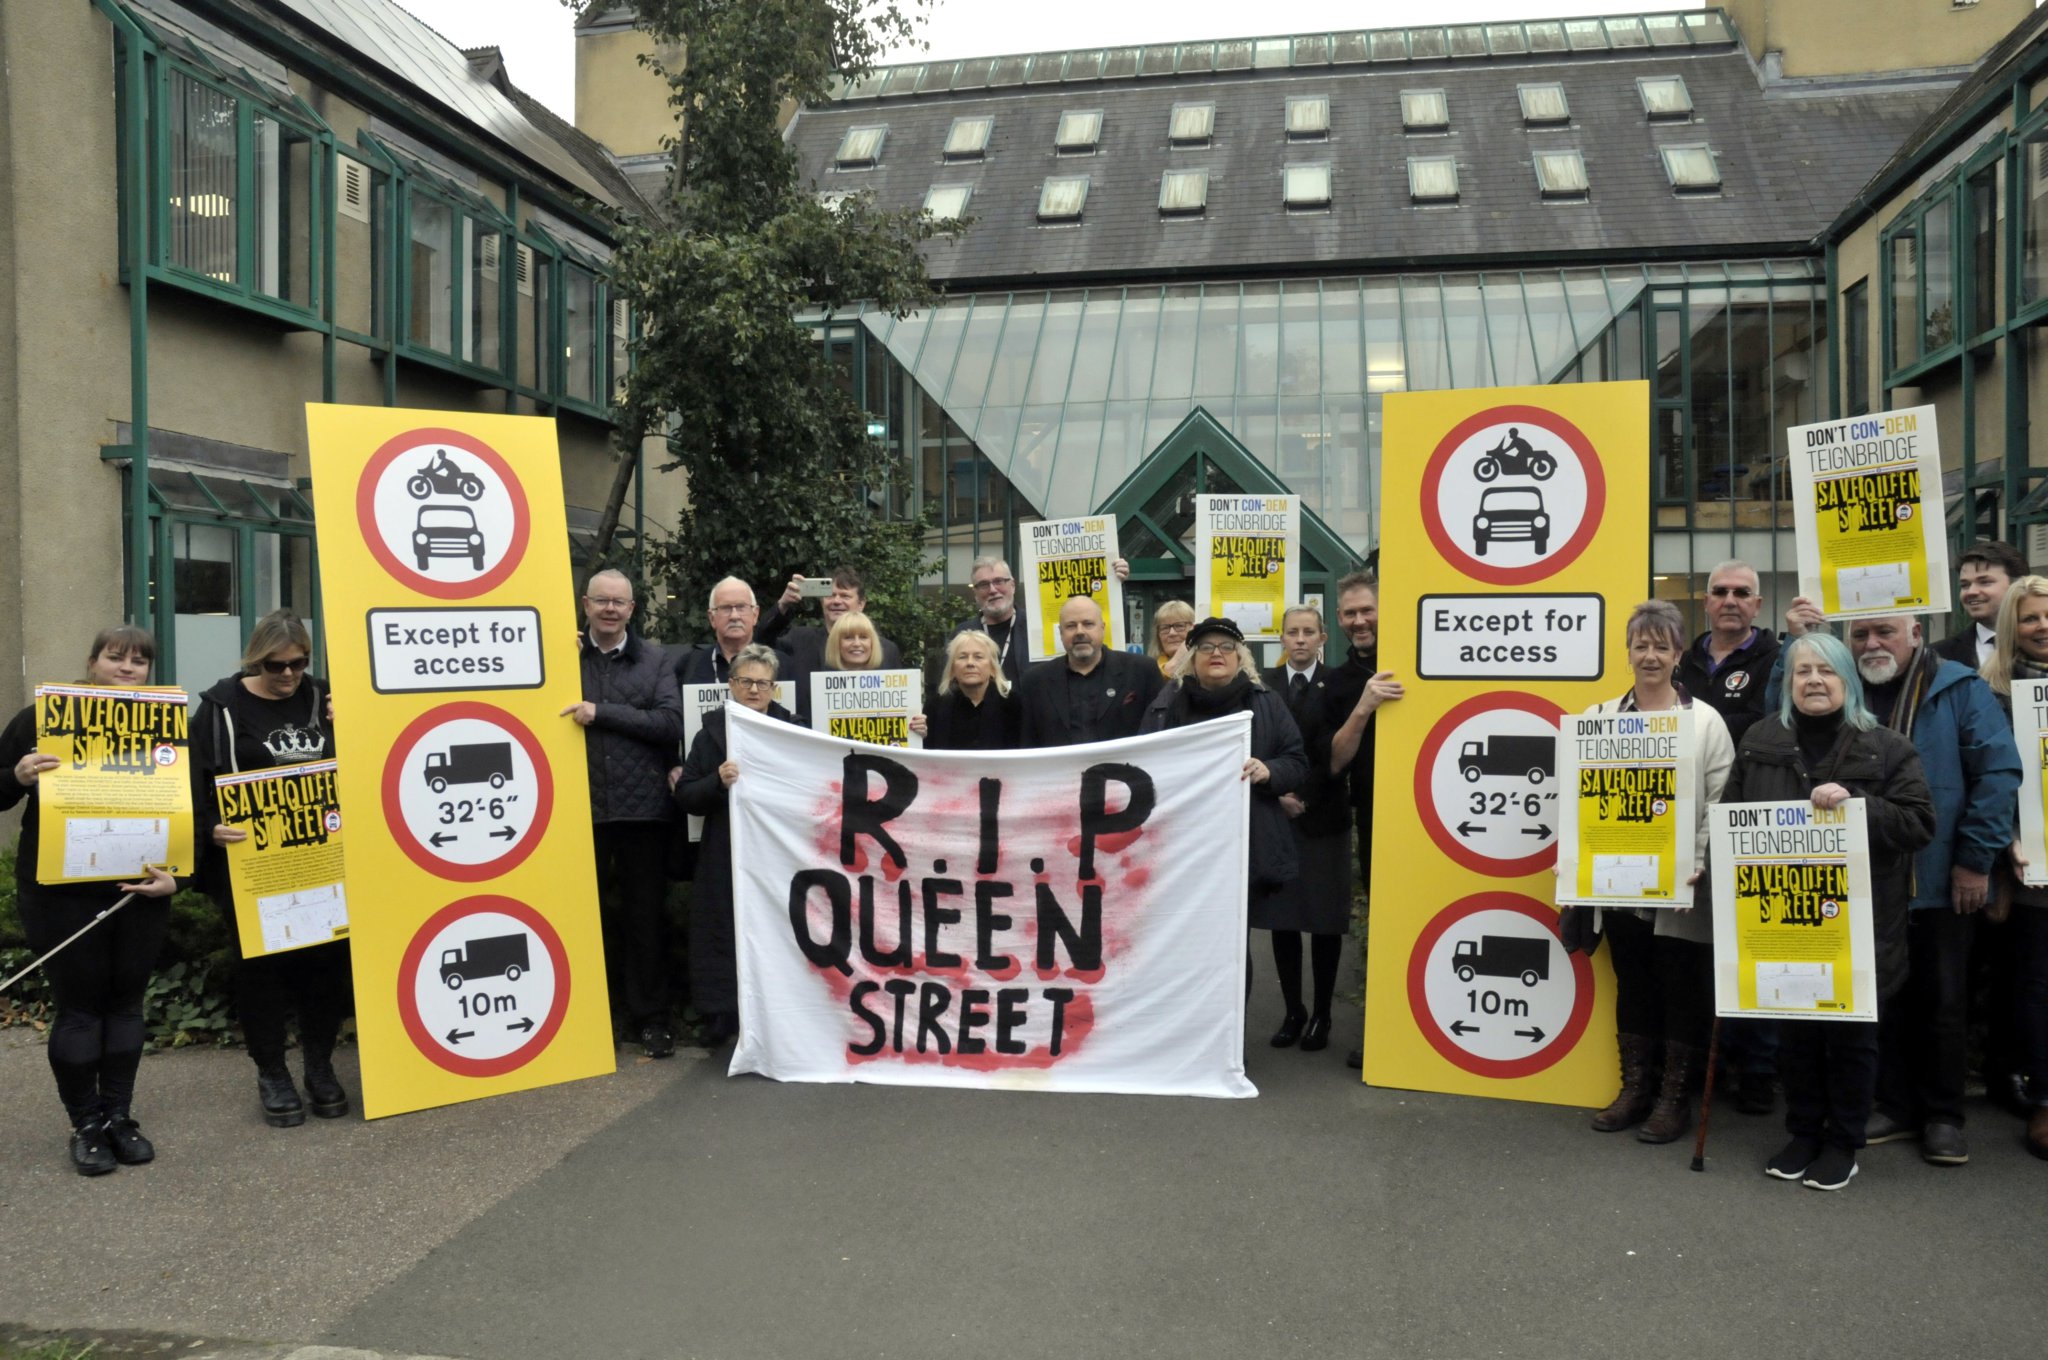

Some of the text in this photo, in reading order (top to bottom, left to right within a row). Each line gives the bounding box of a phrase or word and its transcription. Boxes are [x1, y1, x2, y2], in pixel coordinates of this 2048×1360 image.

[1806, 414, 1917, 447] DON'T CON-DEM
[1806, 435, 1918, 473] TEIGNBRIDGE
[1817, 476, 1858, 507] SAVE
[1864, 470, 1921, 501] QUEEN
[1210, 499, 1288, 512] DON'T CON-DEM
[1838, 498, 1896, 530] STREET
[1032, 519, 1106, 538] DON'T CON-DEM
[1208, 513, 1287, 531] TEIGNBRIDGE
[1032, 534, 1106, 556] TEIGNBRIDGE
[1214, 536, 1286, 559] SAVE QUEEN
[1226, 556, 1268, 575] STREET
[384, 621, 527, 648] Except for
[1434, 608, 1587, 636] Except for
[413, 655, 505, 676] access
[1459, 644, 1558, 663] access
[825, 674, 908, 690] DON'T CON-DEM
[824, 690, 908, 710] TEIGNBRIDGE
[47, 694, 188, 740] SAVE QUEEN
[831, 717, 908, 740] SAVE QUEEN
[1577, 716, 1679, 736] DON'T CON-DEM
[73, 730, 154, 767] STREET
[1576, 736, 1678, 761] TEIGNBRIDGE
[1582, 768, 1676, 796] SAVE QUEEN
[222, 778, 277, 818] SAVE
[1599, 791, 1652, 818] STREET
[253, 804, 326, 847] STREET
[1729, 806, 1847, 828] DON'T CON-DEM
[1728, 828, 1848, 855] TEIGNBRIDGE
[1739, 865, 1848, 896] SAVE QUEEN
[1760, 892, 1821, 920] STREET
[789, 867, 1103, 976] QUEEN
[458, 992, 517, 1019] 10m
[1466, 989, 1529, 1017] 10m
[848, 981, 1075, 1057] STREET
